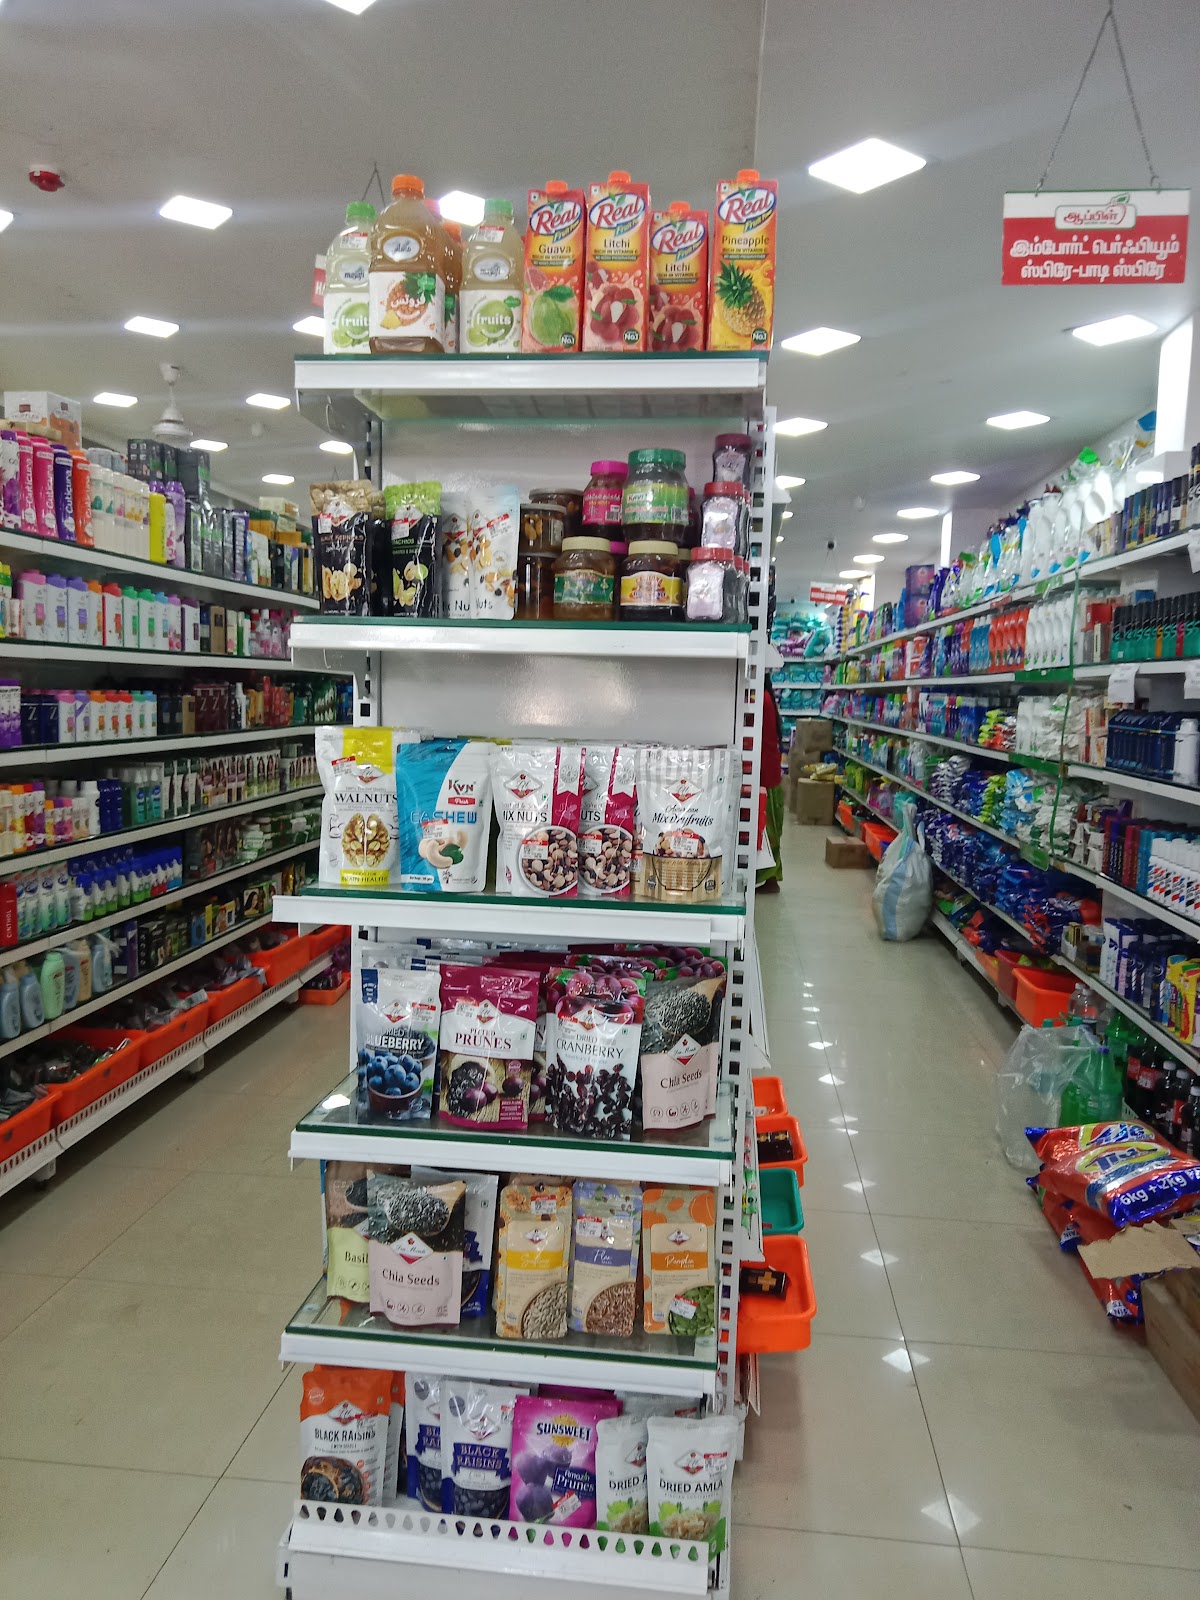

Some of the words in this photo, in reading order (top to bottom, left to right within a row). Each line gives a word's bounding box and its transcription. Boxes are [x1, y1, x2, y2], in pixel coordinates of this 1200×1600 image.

[595, 196, 640, 230] Real
[724, 190, 770, 226] Real
[534, 203, 578, 236] Real
[604, 238, 630, 248] Litchi
[657, 222, 700, 255] Real
[721, 235, 770, 248] Pineapple
[538, 244, 572, 255] Guava
[665, 263, 691, 272] Litchi
[475, 312, 512, 326] fruits
[65, 469, 73, 514] Cuticura
[335, 793, 398, 804] WALNUTS
[410, 811, 477, 824] CASHEW
[652, 812, 668, 824] Mix
[669, 813, 714, 828] Dryfruits
[366, 1032, 424, 1051] BLUEBERRY
[455, 1033, 512, 1050] PRUNES
[556, 1038, 624, 1059] CRANBERRY
[660, 1075, 680, 1089] Chia
[682, 1068, 702, 1084] Seeds
[1120, 1189, 1149, 1205] 6kg
[1157, 1174, 1187, 1190] 2kg
[382, 1268, 404, 1283] Chia
[407, 1273, 440, 1286] Seeds
[314, 1429, 339, 1441] BLACK
[536, 1422, 592, 1441] SUNSWEET
[460, 1445, 500, 1459] BLACK
[457, 1456, 503, 1469] RAISINS
[557, 1474, 594, 1492] Prunes
[609, 1476, 640, 1490] DRIED
[659, 1479, 691, 1493] DRIED
[695, 1479, 723, 1493] AMLA
